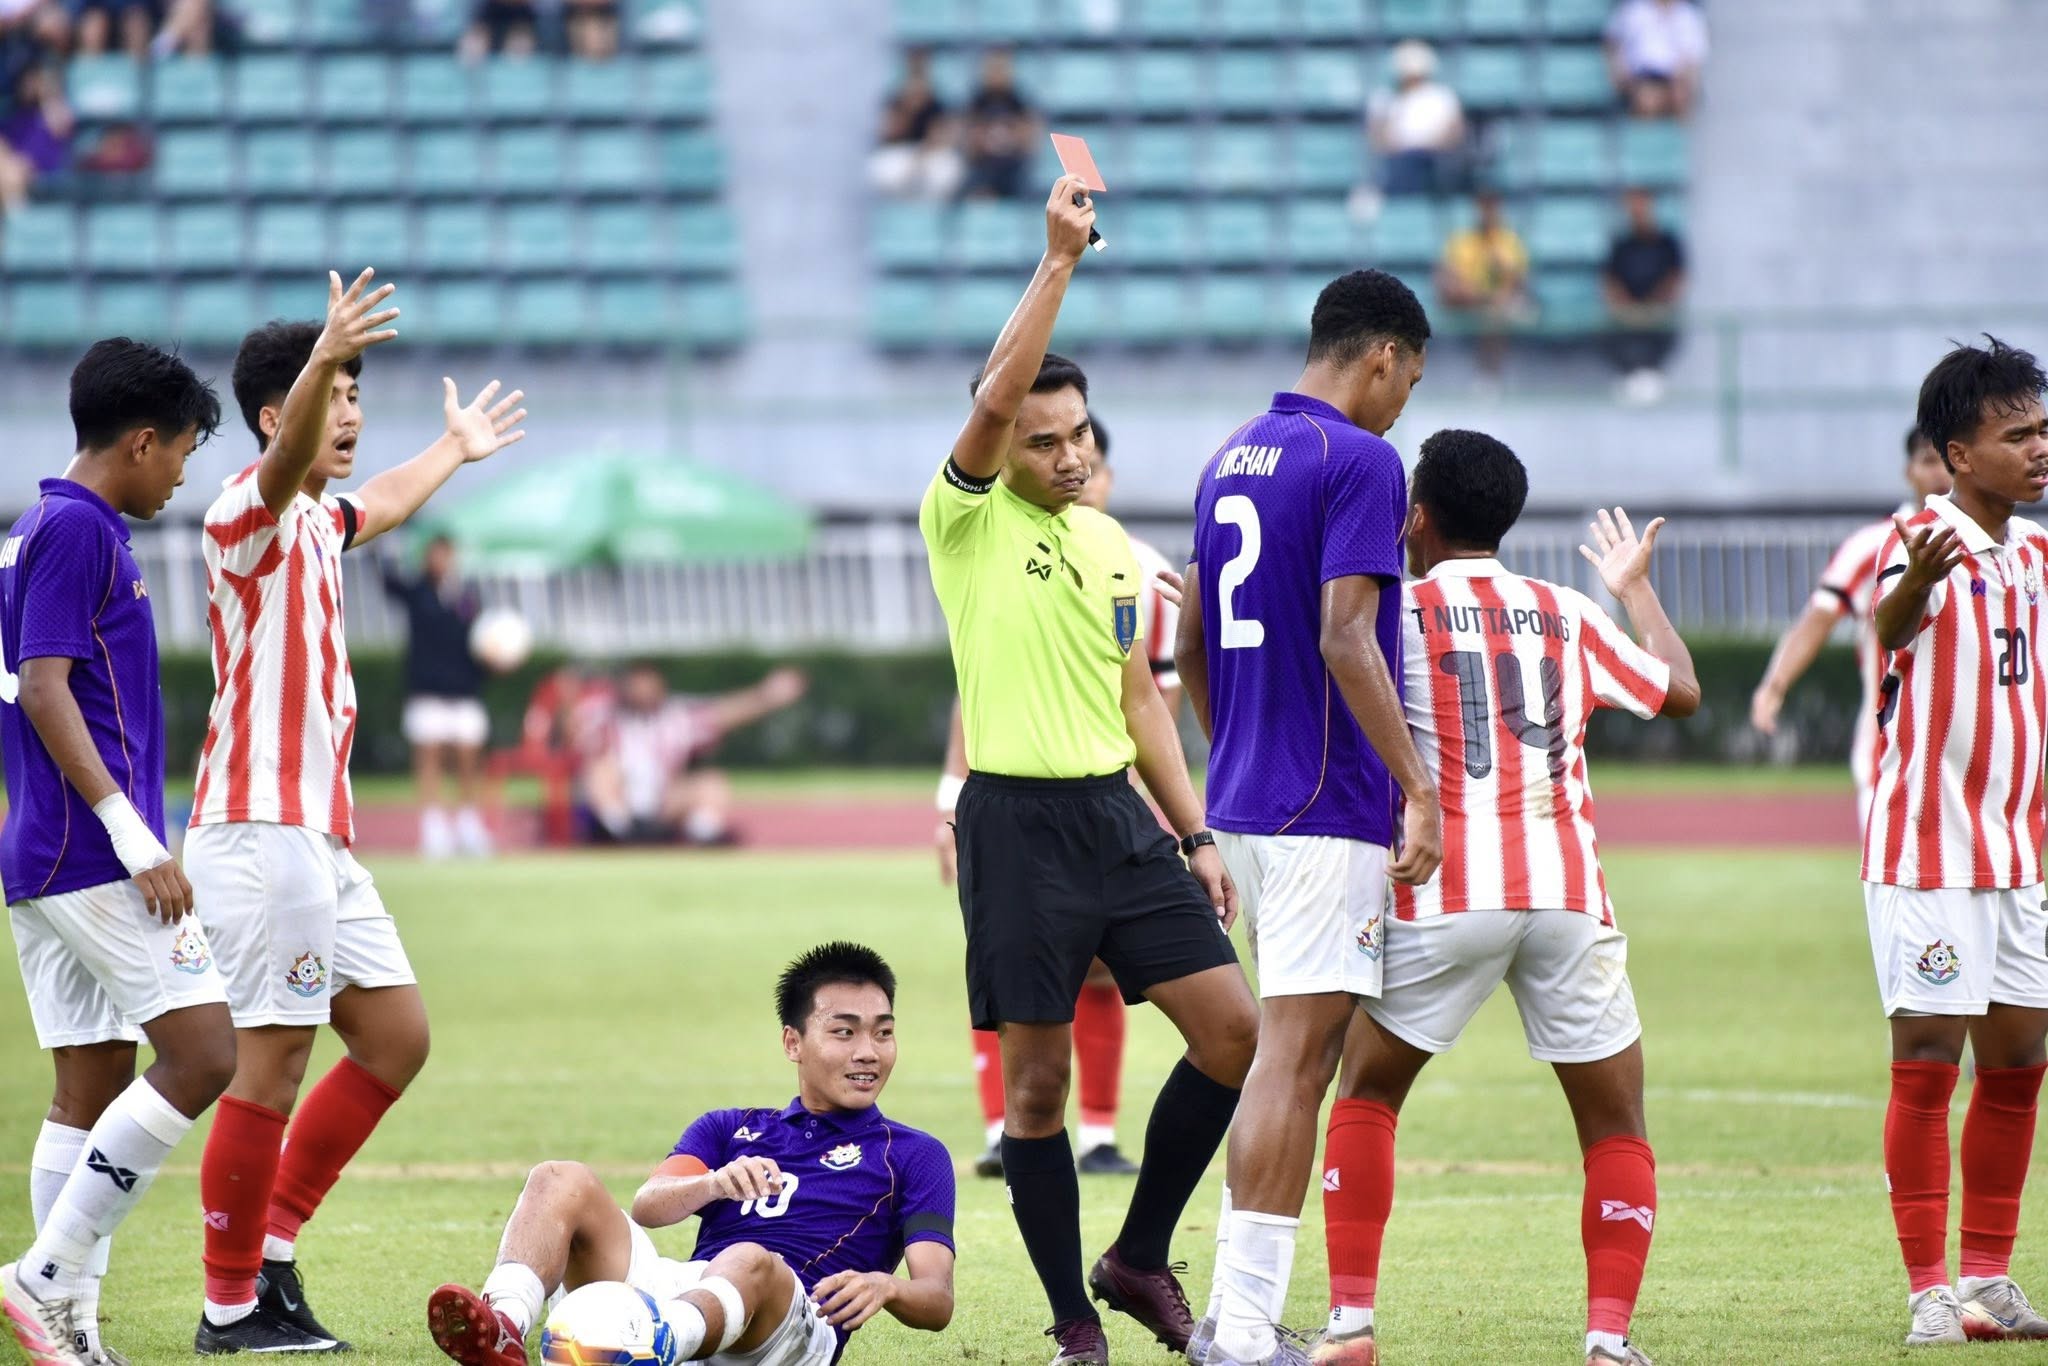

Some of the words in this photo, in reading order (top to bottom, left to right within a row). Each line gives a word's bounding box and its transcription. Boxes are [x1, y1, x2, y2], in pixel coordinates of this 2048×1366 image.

[1214, 494, 1265, 649] 2
[1439, 650, 1568, 785] 14
[1994, 627, 2028, 687] 20
